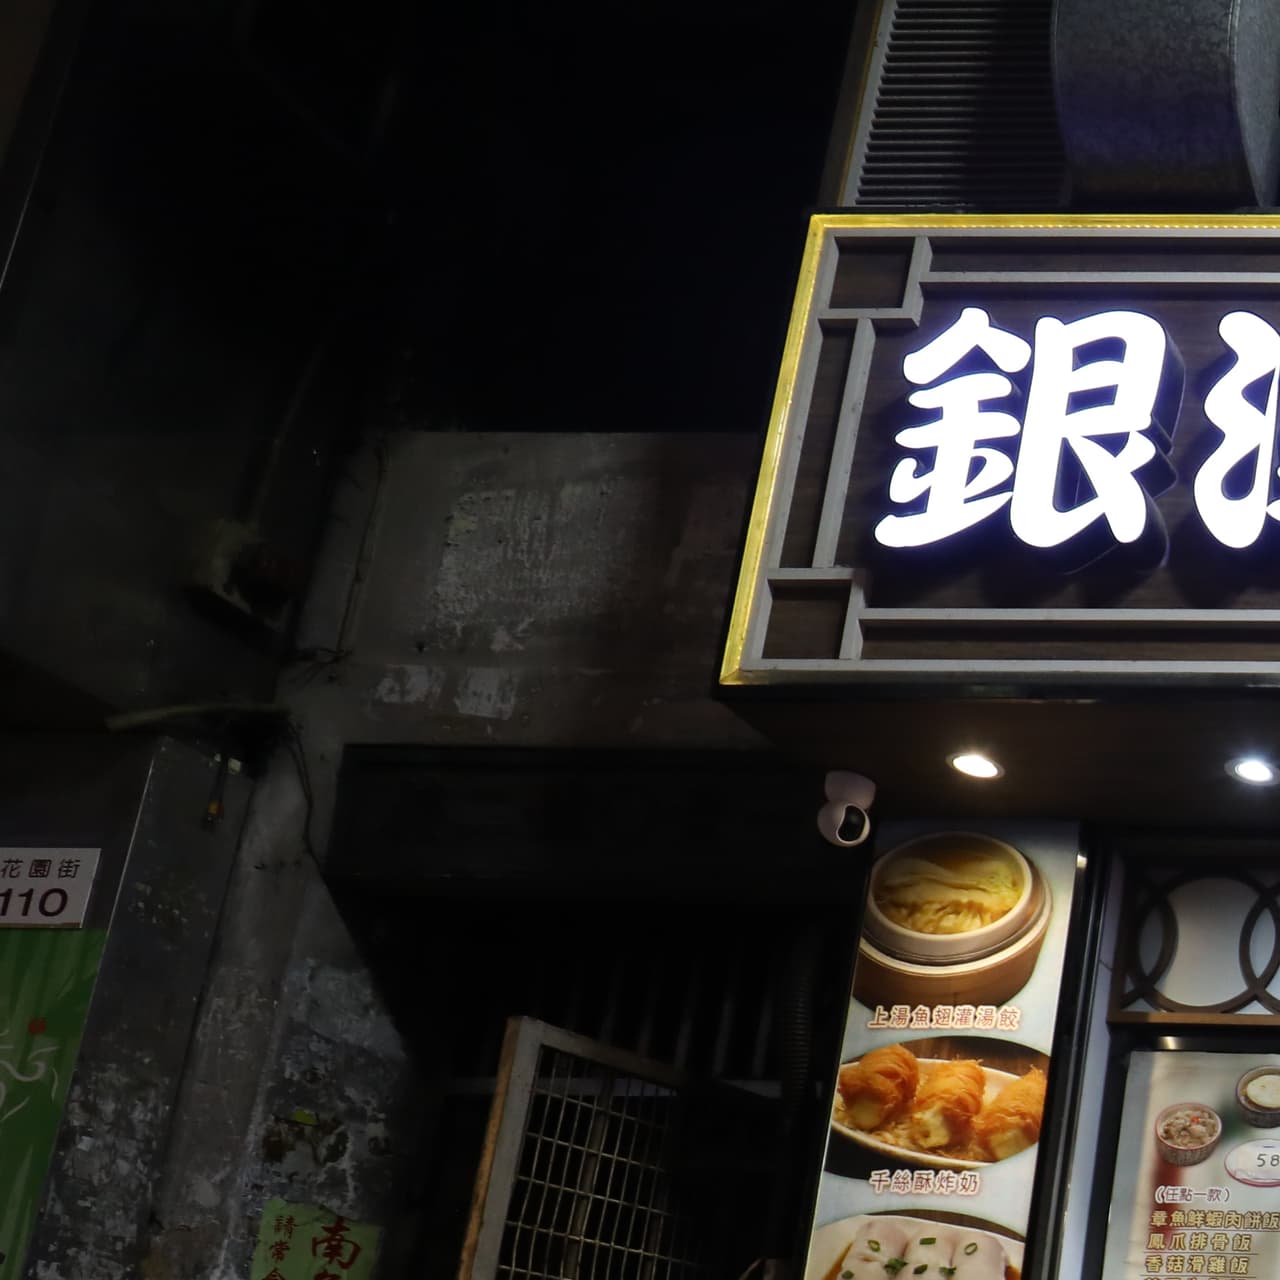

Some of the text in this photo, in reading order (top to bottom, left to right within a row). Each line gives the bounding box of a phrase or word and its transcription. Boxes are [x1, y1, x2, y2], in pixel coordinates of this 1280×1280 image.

[0, 858, 81, 878] 花園街
[0, 888, 68, 917] 110
[866, 1004, 1022, 1032] 上湯魚翅灌湯餃
[1255, 1152, 1280, 1168] 58
[868, 1169, 981, 1196] 千絲酥炸奶
[1150, 1209, 1280, 1231] 章魚鮮蝦肉餅飯
[1148, 1232, 1252, 1252] 鳳爪排骨飯
[1145, 1255, 1249, 1275] 香菇滑雞飯
